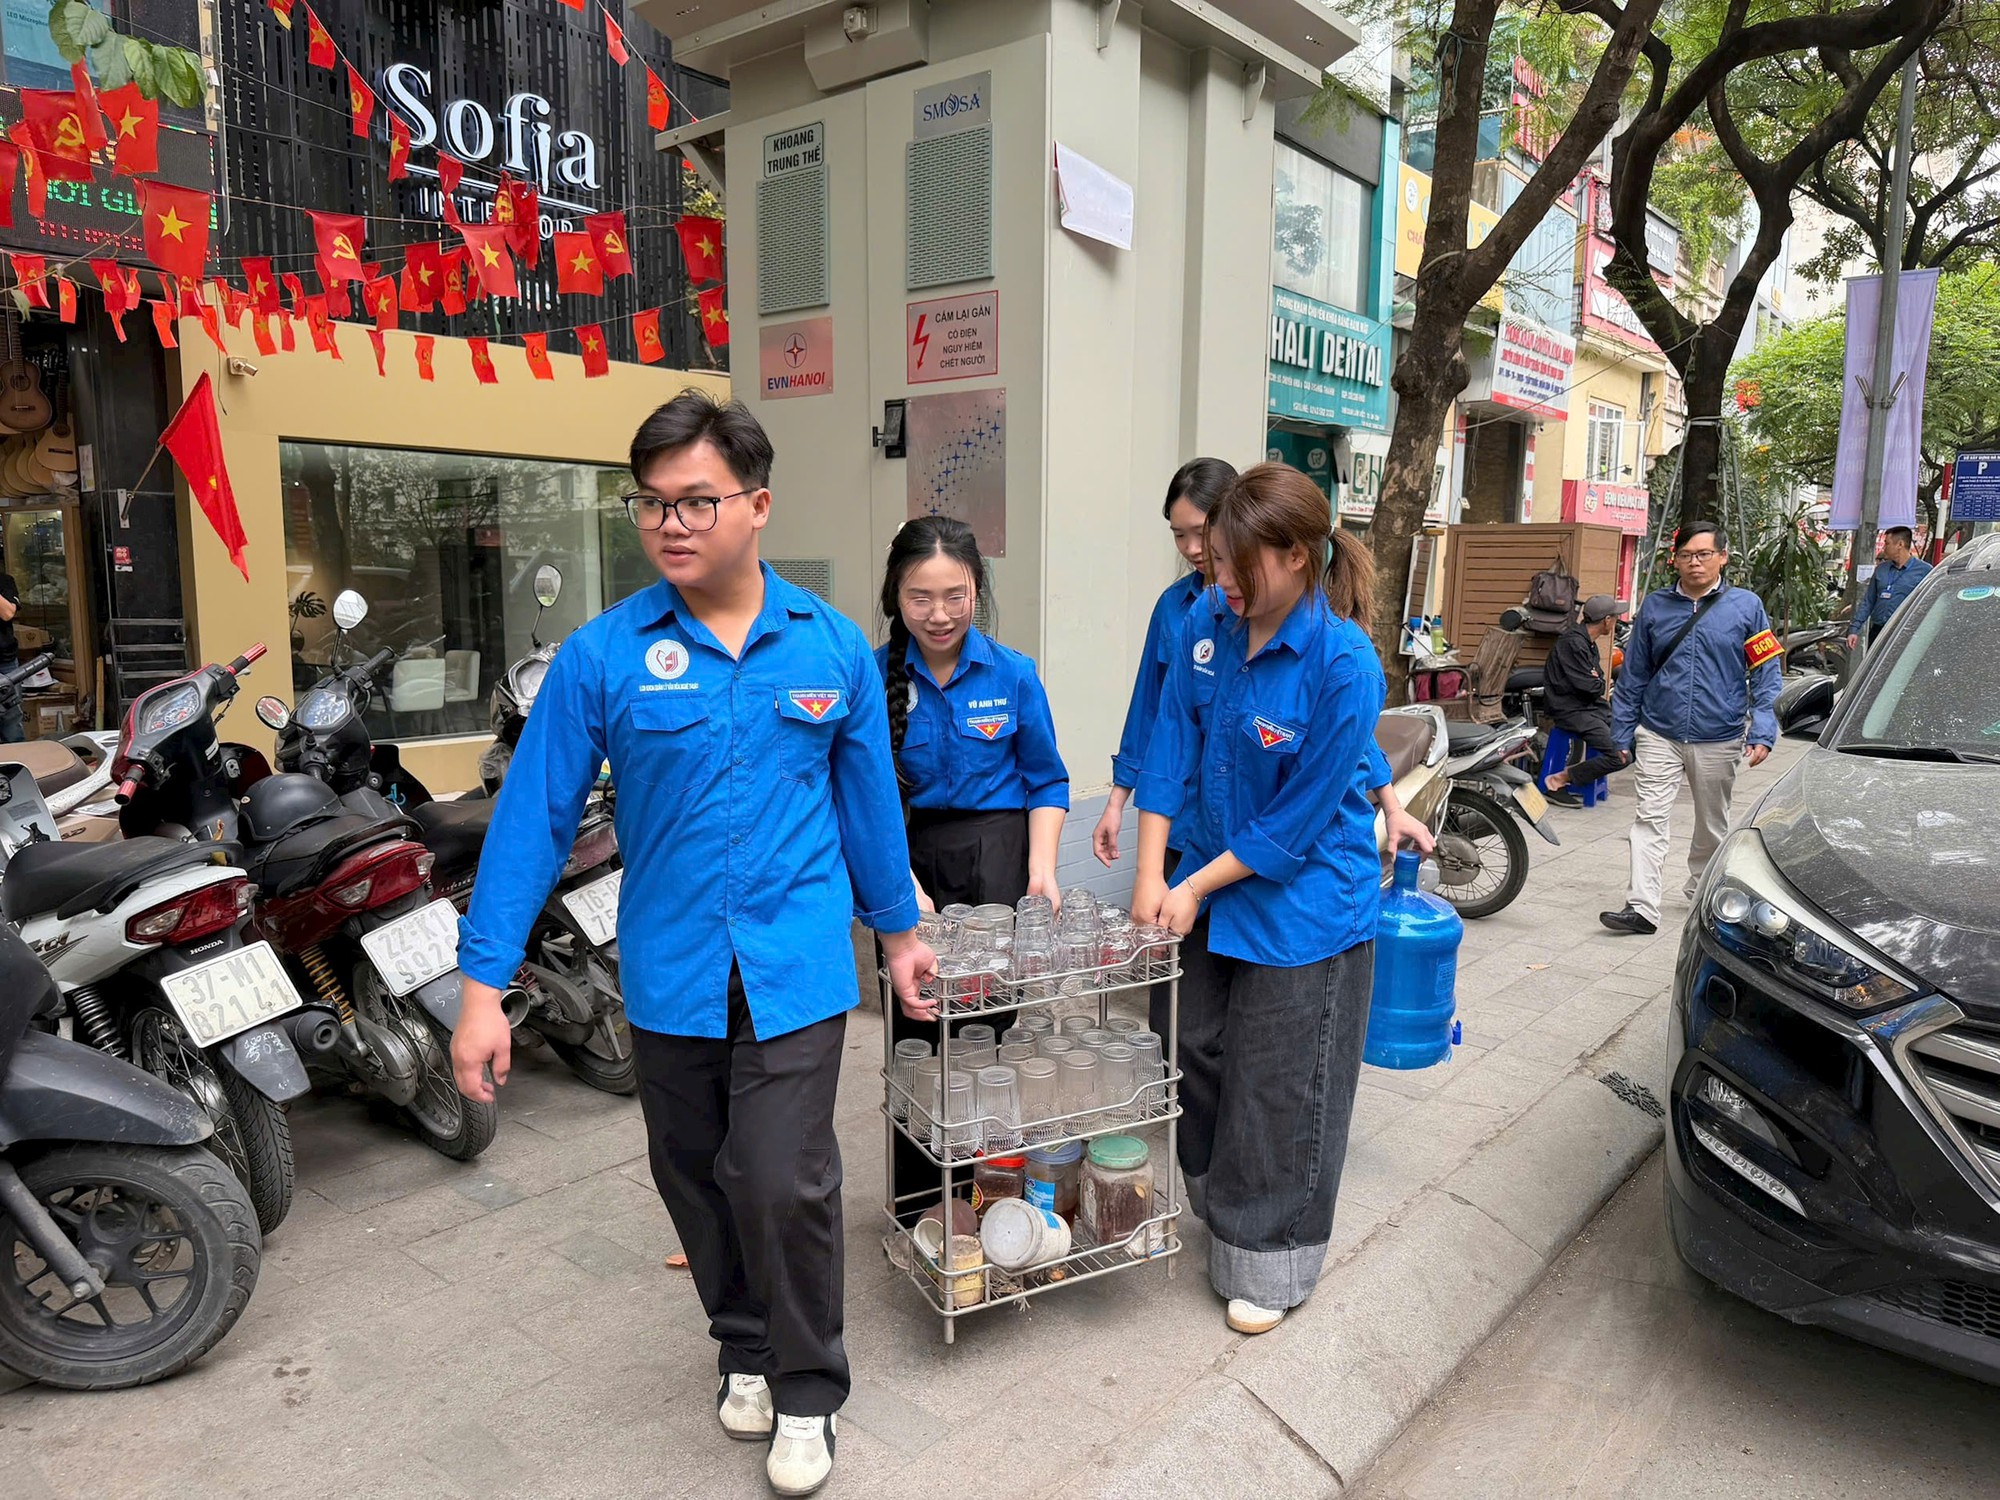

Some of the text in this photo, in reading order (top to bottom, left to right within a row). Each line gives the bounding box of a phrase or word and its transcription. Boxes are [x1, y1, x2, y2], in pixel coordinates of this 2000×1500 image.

[383, 62, 600, 195] Sofia
[772, 129, 815, 152] KHOANG
[767, 142, 821, 175] TRUNG THẾ
[935, 305, 991, 323] CẤM LẠI GẦN
[947, 327, 978, 339] CÓ ĐIỆN
[942, 339, 983, 354] NGUY HIỂM
[1271, 315, 1384, 387] HALI DENTAL
[939, 354, 985, 369] CHẾT NGƯỜI
[767, 371, 825, 390] EVNHANOI
[1977, 461, 1988, 475] P
[189, 940, 225, 955] HONDA
